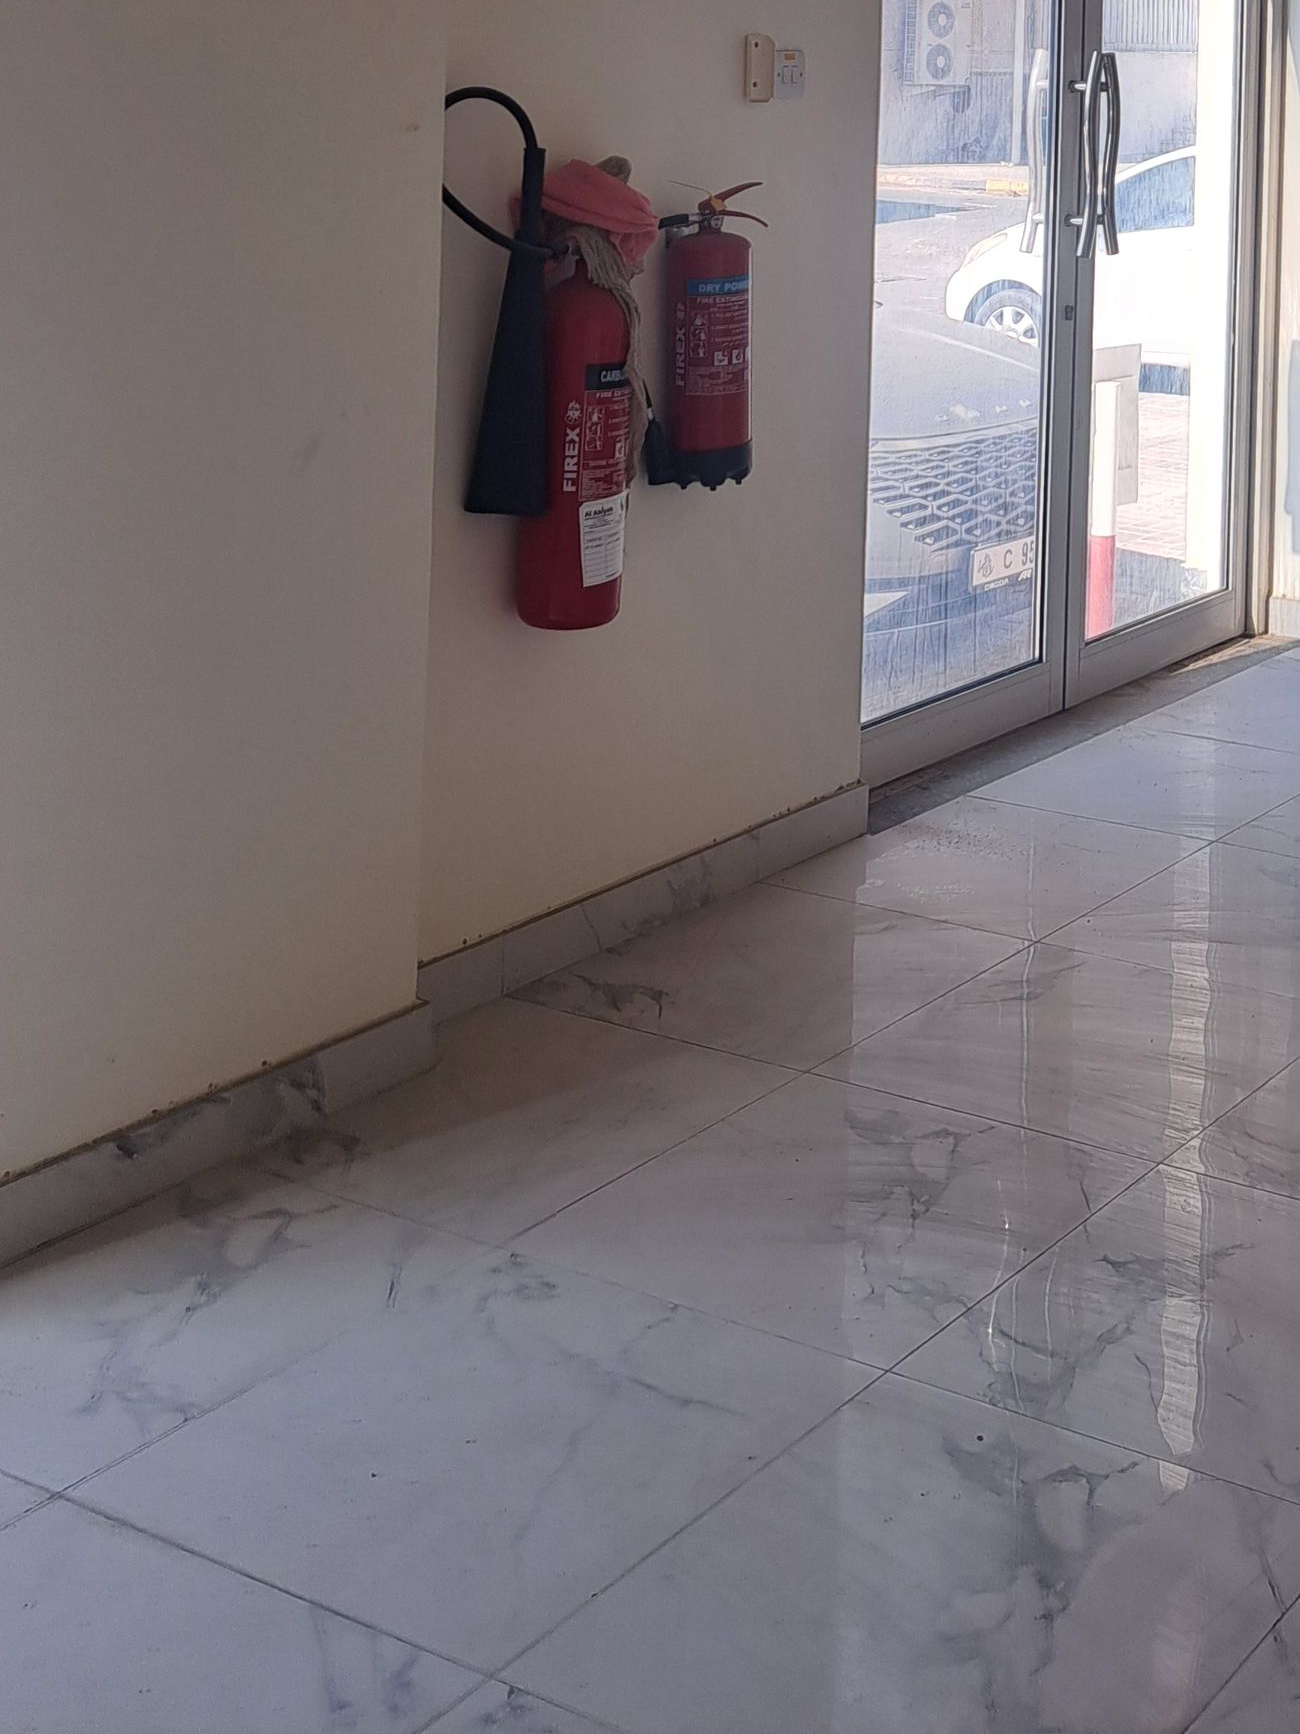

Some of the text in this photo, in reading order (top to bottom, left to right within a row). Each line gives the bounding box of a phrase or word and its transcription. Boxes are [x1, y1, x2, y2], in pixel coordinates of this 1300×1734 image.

[698, 282, 721, 293] DRY
[675, 327, 685, 386] FIREX
[563, 426, 580, 492] FIREX
[1003, 549, 1013, 569] C
